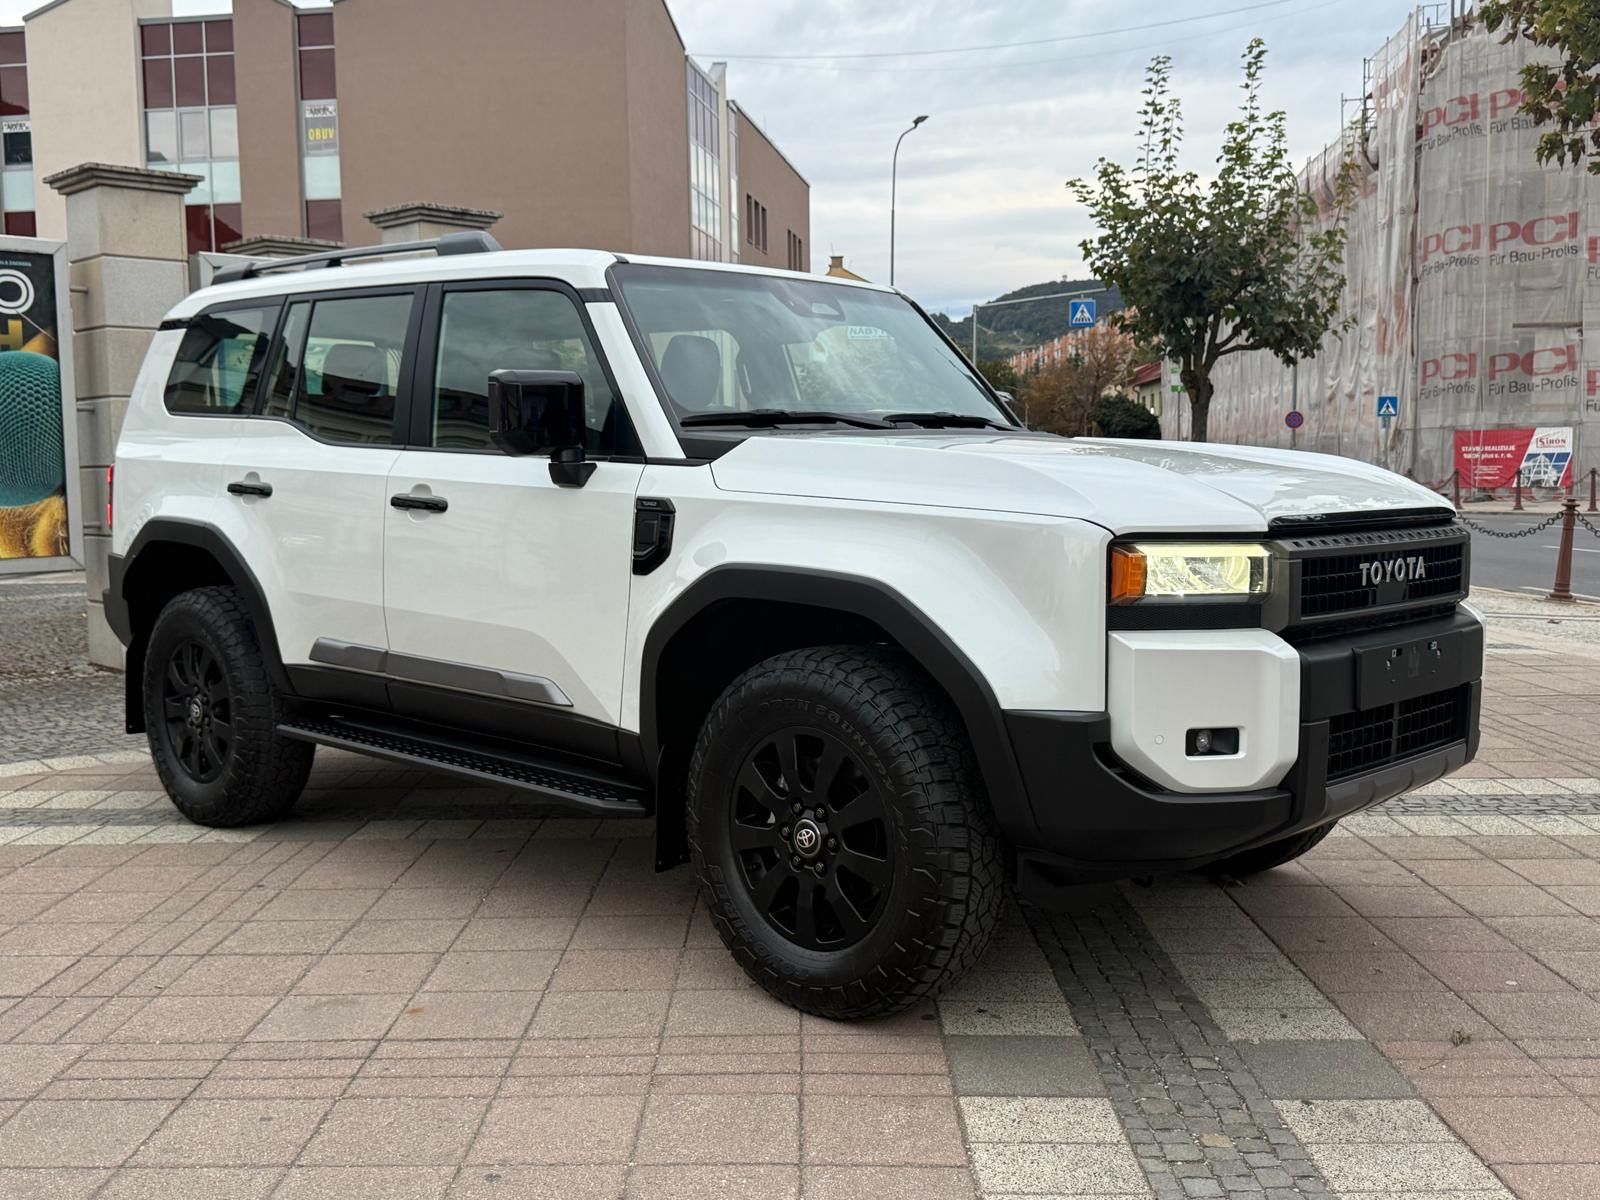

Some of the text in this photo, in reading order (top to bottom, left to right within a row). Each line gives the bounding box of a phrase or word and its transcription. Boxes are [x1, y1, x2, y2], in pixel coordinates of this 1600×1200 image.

[1423, 95, 1479, 136] PCI
[308, 127, 335, 141] OBUV
[1423, 224, 1481, 262] PCI
[1489, 211, 1578, 252] PCI
[1510, 244, 1579, 263] Bau-Profis
[1421, 353, 1477, 385] PCI
[1489, 345, 1577, 381] PCI
[1508, 375, 1578, 394] Bau-Profis
[1360, 556, 1426, 586] TOYOTA
